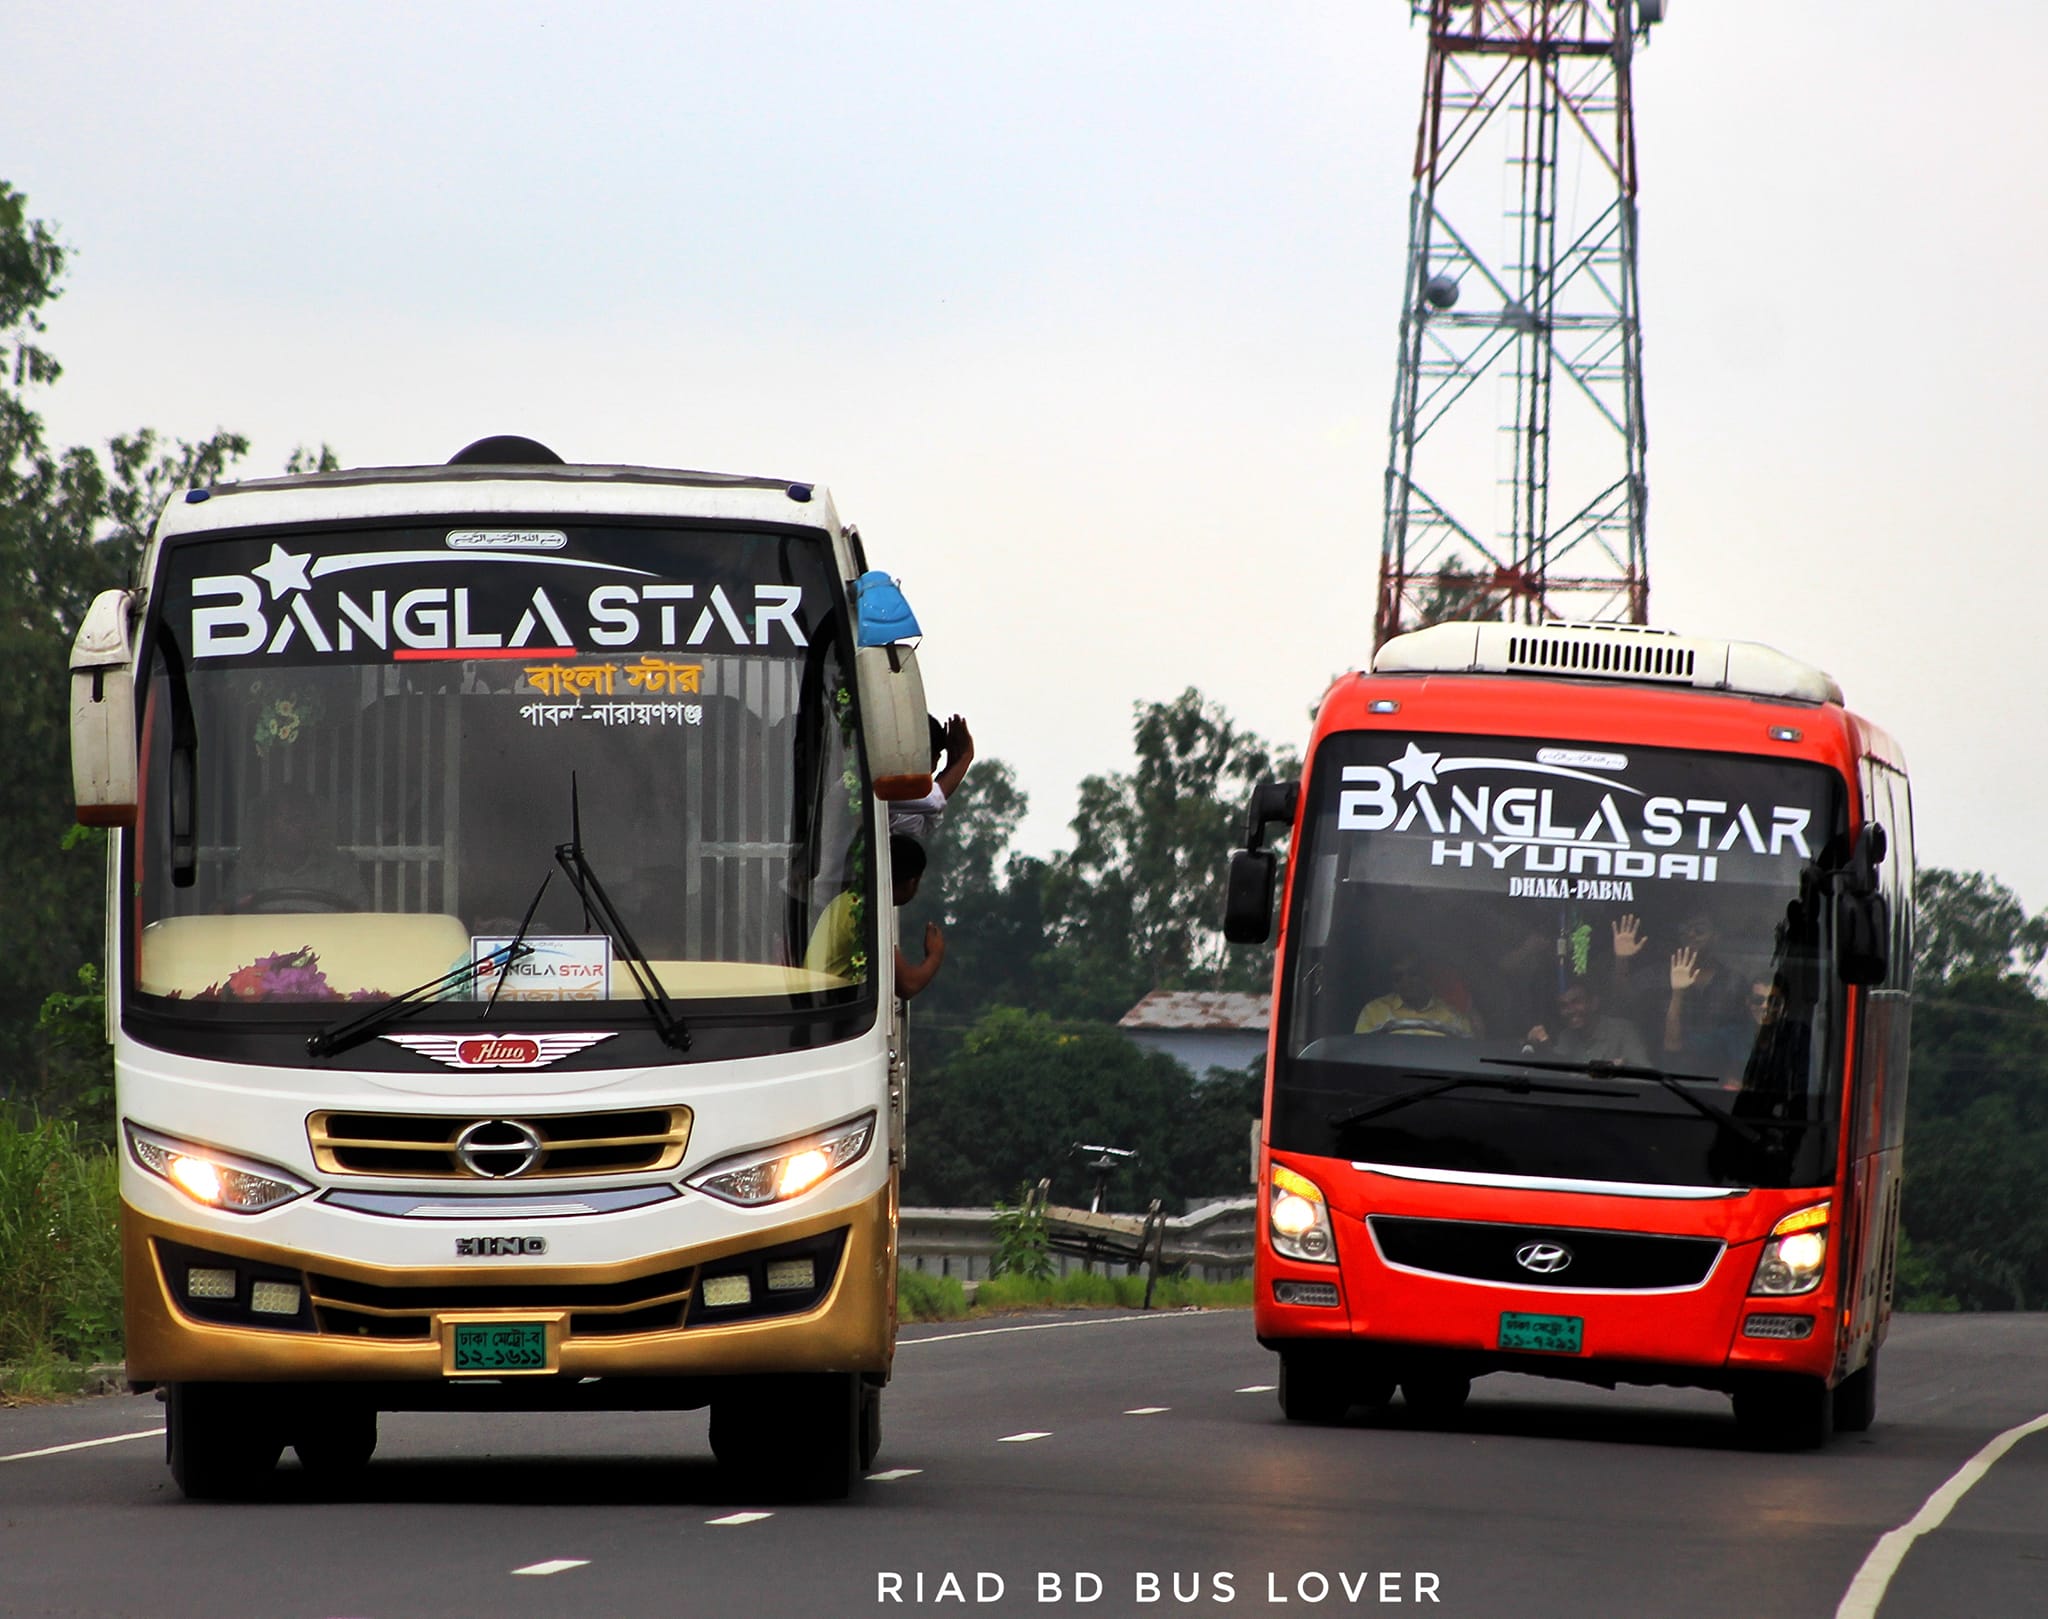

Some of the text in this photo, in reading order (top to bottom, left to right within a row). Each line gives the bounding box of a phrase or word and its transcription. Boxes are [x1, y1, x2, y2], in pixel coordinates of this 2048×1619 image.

[192, 575, 809, 658] BANGLA STAR
[523, 655, 704, 696] বাংলা স্টার
[1338, 765, 1812, 858] BANGLA STAR
[1431, 840, 1717, 881] HYUNDAI
[1509, 877, 1634, 901] DHAKA-PABNA
[559, 964, 604, 976] STAR
[472, 1042, 526, 1063] Hino
[459, 1331, 488, 1346] ঢাকা
[458, 1349, 542, 1366] ১২-১৬১১
